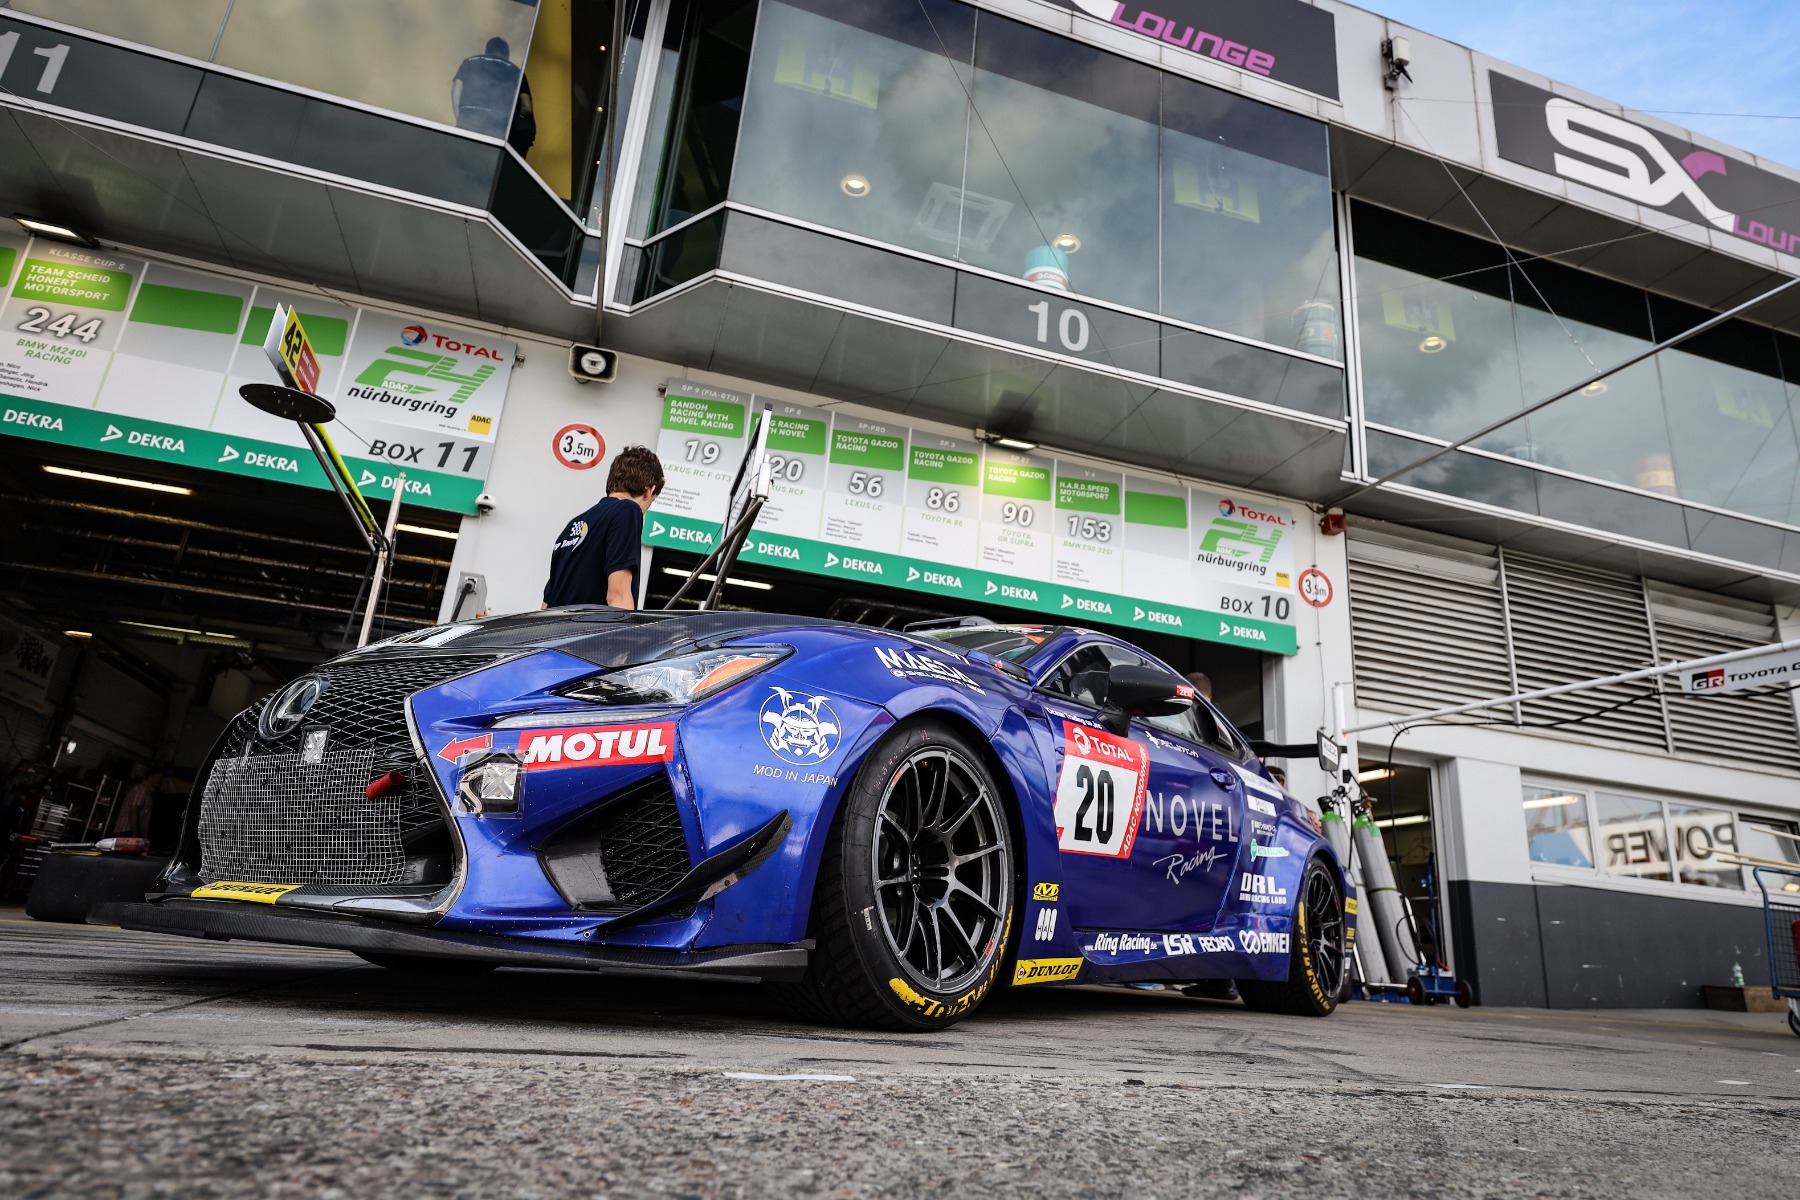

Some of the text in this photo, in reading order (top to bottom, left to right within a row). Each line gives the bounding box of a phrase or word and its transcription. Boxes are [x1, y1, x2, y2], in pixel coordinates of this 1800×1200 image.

[48, 248, 92, 263] KLASSE
[93, 258, 116, 268] CUP
[26, 274, 78, 287] HONERT
[30, 264, 111, 283] TEAM SCHEID
[24, 282, 110, 301] MOTORSPORT
[18, 307, 102, 342] 244
[1028, 300, 1090, 352] 10
[16, 339, 49, 351] BMW
[431, 334, 504, 361] TOTAL
[25, 350, 72, 365] RACING
[380, 380, 409, 393] ADAC
[681, 384, 693, 392] SP
[347, 386, 458, 419] nürburgring
[670, 400, 708, 411] BANDOH
[3, 409, 64, 431] DEKRA
[470, 414, 492, 424] ADAC
[669, 408, 729, 422] RACING WITH
[669, 415, 734, 430] NOVEL RACING
[778, 420, 810, 431] RACING
[778, 429, 806, 438] NOVEL
[858, 422, 886, 433] SP-PRO
[127, 430, 186, 453] DEKRA
[836, 434, 898, 448] TOYOTA GAZOO
[836, 442, 867, 452] RACING
[368, 439, 480, 473] BOX 11
[685, 439, 720, 465] 19
[914, 450, 973, 465] TOYOTA GAZOO
[243, 451, 299, 473] DEKRA
[770, 456, 804, 481] 20
[914, 458, 944, 468] RACING
[663, 463, 692, 475] LEXUS
[693, 469, 705, 477] RC
[715, 473, 732, 482] GT3
[988, 466, 1045, 480] TOYOTA GAZOO
[988, 474, 1016, 484] RACING
[849, 471, 883, 497] 56
[926, 487, 960, 513] 86
[1060, 488, 1109, 500] MOTORSPORT
[1060, 496, 1074, 504] E.V.
[845, 499, 883, 511] LEXUS LC
[1002, 502, 1034, 526] 90
[921, 513, 964, 527] TOYOTA 86
[1237, 506, 1287, 526] TOTAL
[669, 526, 714, 544] DEKRA
[1002, 528, 1032, 540] TOYOTA
[1068, 516, 1111, 542] 153
[998, 535, 1034, 548] GR SUPRA
[1063, 540, 1081, 549] BMW
[1082, 544, 1096, 552] E90
[758, 542, 800, 560] DEKRA
[1216, 546, 1234, 556] ADAC
[842, 557, 884, 575] DEKRA
[1197, 553, 1267, 576] nürburgring
[923, 572, 962, 588] DEKRA
[1001, 584, 1039, 602] DEKRA
[1076, 598, 1113, 614] DEKRA
[1220, 594, 1290, 620] BOX 10
[1148, 611, 1183, 627] DEKRA
[1233, 626, 1266, 642] DEKRA
[1692, 676, 1724, 690] GR
[1728, 666, 1788, 682] TOYOTA
[523, 728, 668, 764] MOTUL
[1089, 735, 1134, 763] TOTAL
[753, 764, 839, 787] MOD IN JAPAN
[1074, 764, 1115, 845] 20
[1146, 790, 1238, 843] NOVEL
[1123, 816, 1137, 856] ADAC
[1152, 845, 1228, 885] Racing
[1240, 872, 1287, 896] DRL
[1271, 896, 1287, 905] LABO
[1198, 936, 1236, 953] RECARO
[1260, 932, 1290, 954] ENKEI
[1026, 964, 1079, 978] DUNLOP
